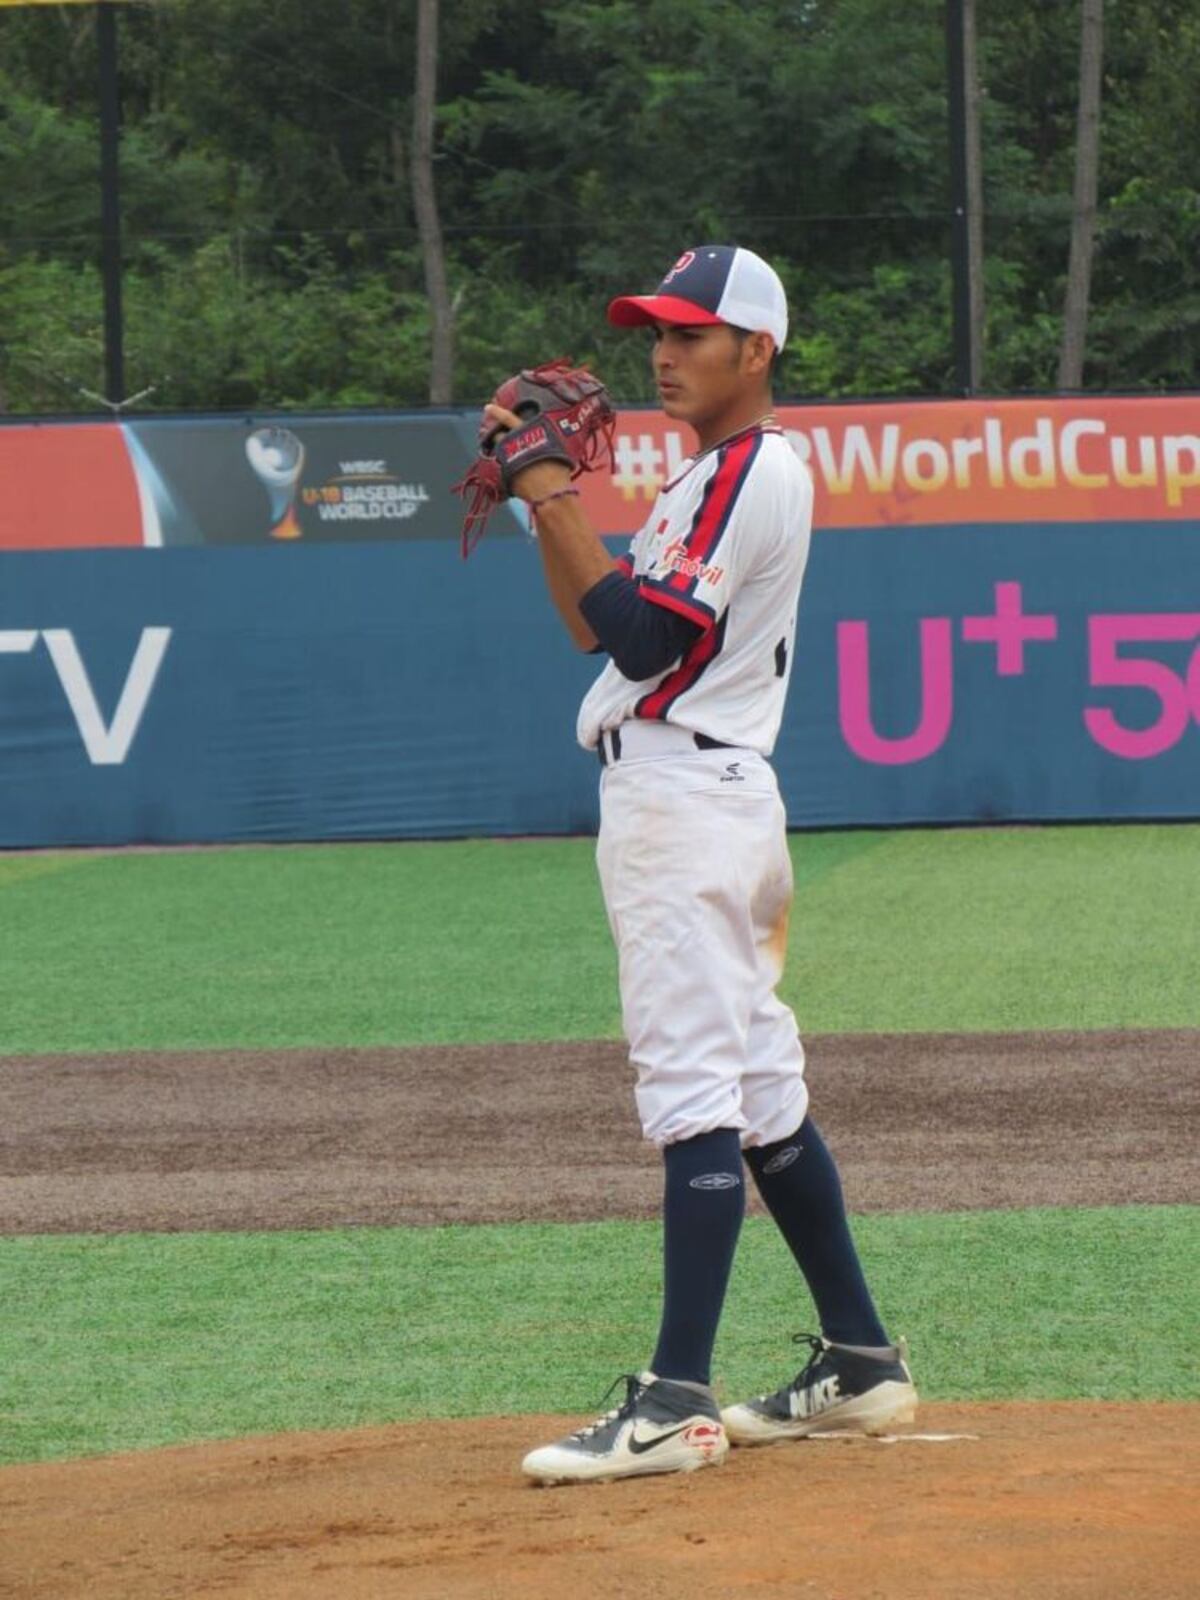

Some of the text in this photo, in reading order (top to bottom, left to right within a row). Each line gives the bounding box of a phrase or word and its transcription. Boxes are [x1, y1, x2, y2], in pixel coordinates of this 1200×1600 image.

[663, 251, 696, 284] P
[342, 484, 429, 502] BASEBALL
[318, 502, 418, 520] WORLD CUP
[1083, 612, 1200, 760] 5
